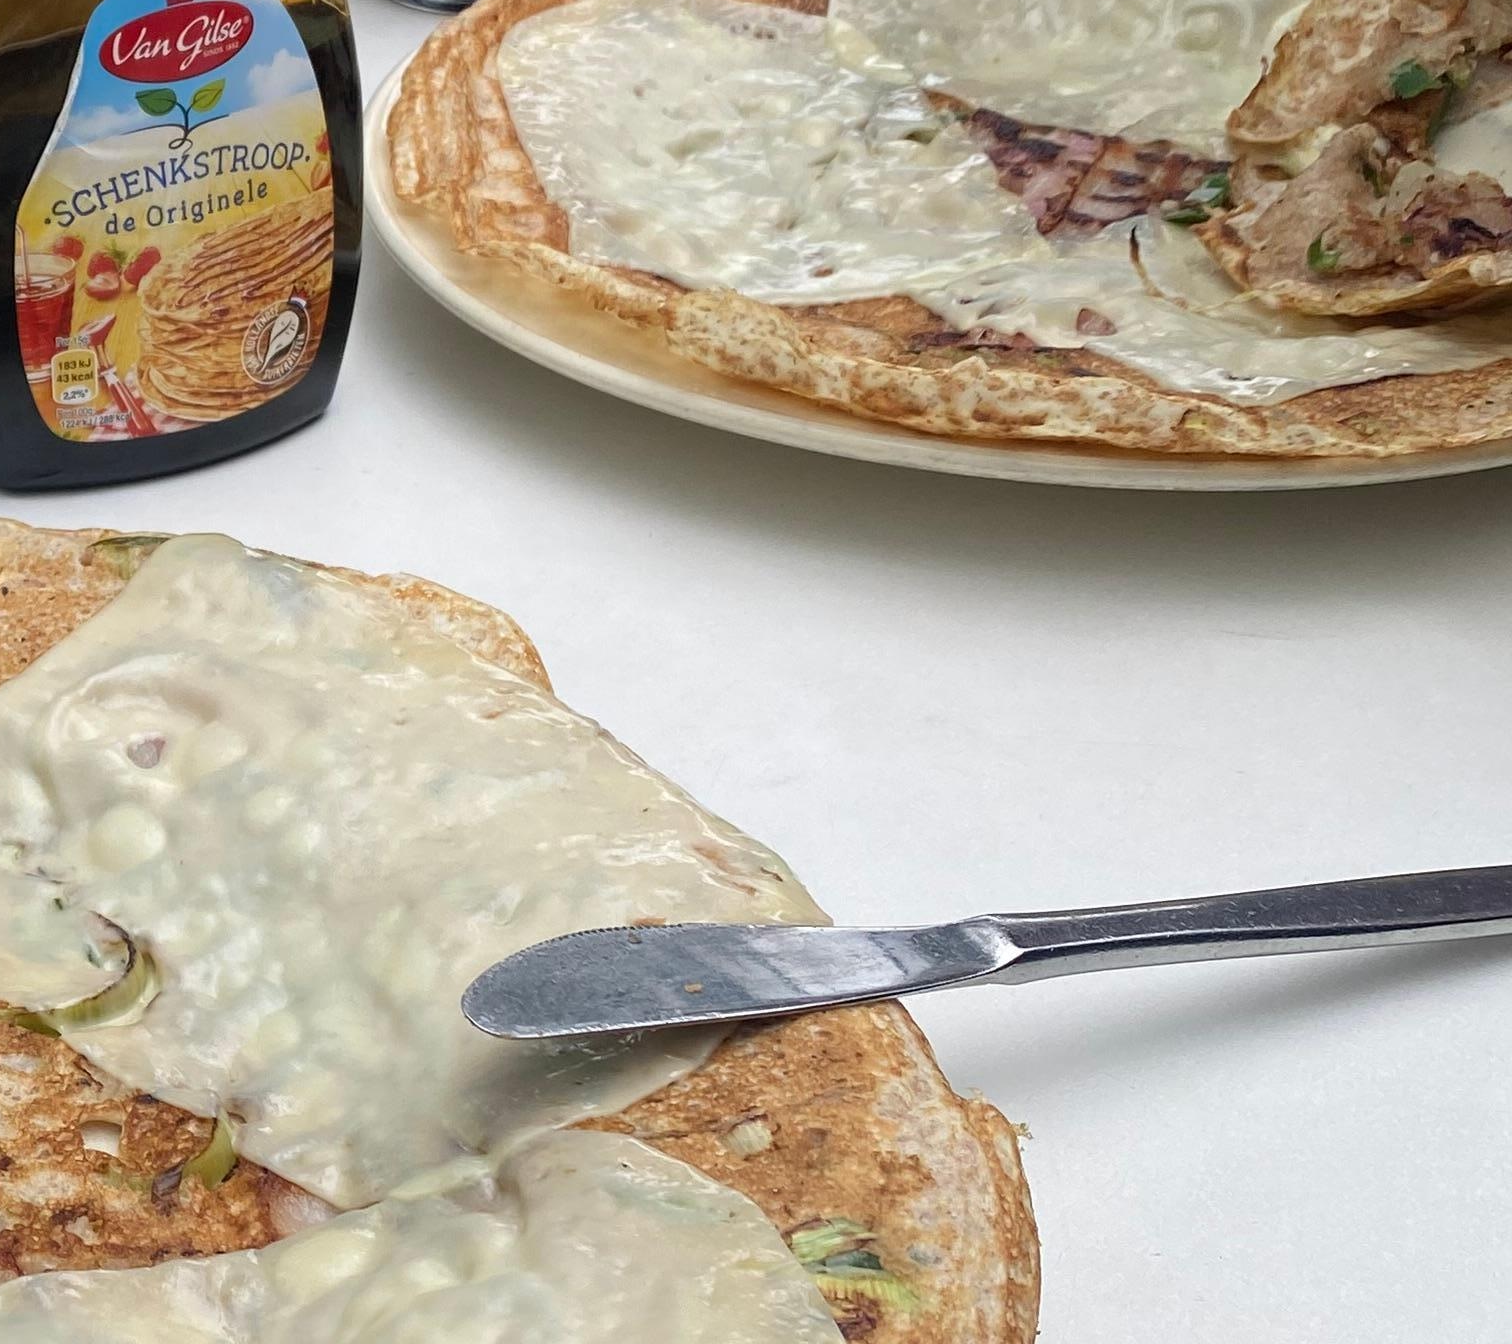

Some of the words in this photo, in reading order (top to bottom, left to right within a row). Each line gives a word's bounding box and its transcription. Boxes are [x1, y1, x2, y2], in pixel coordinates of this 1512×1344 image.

[112, 27, 171, 66] Van
[176, 9, 244, 72] Gilse
[105, 213, 136, 235] de
[146, 179, 268, 228] Originele
[57, 374, 69, 384] 43
[71, 371, 93, 382] kcal
[59, 360, 77, 371] 183
[79, 358, 91, 368] kJ
